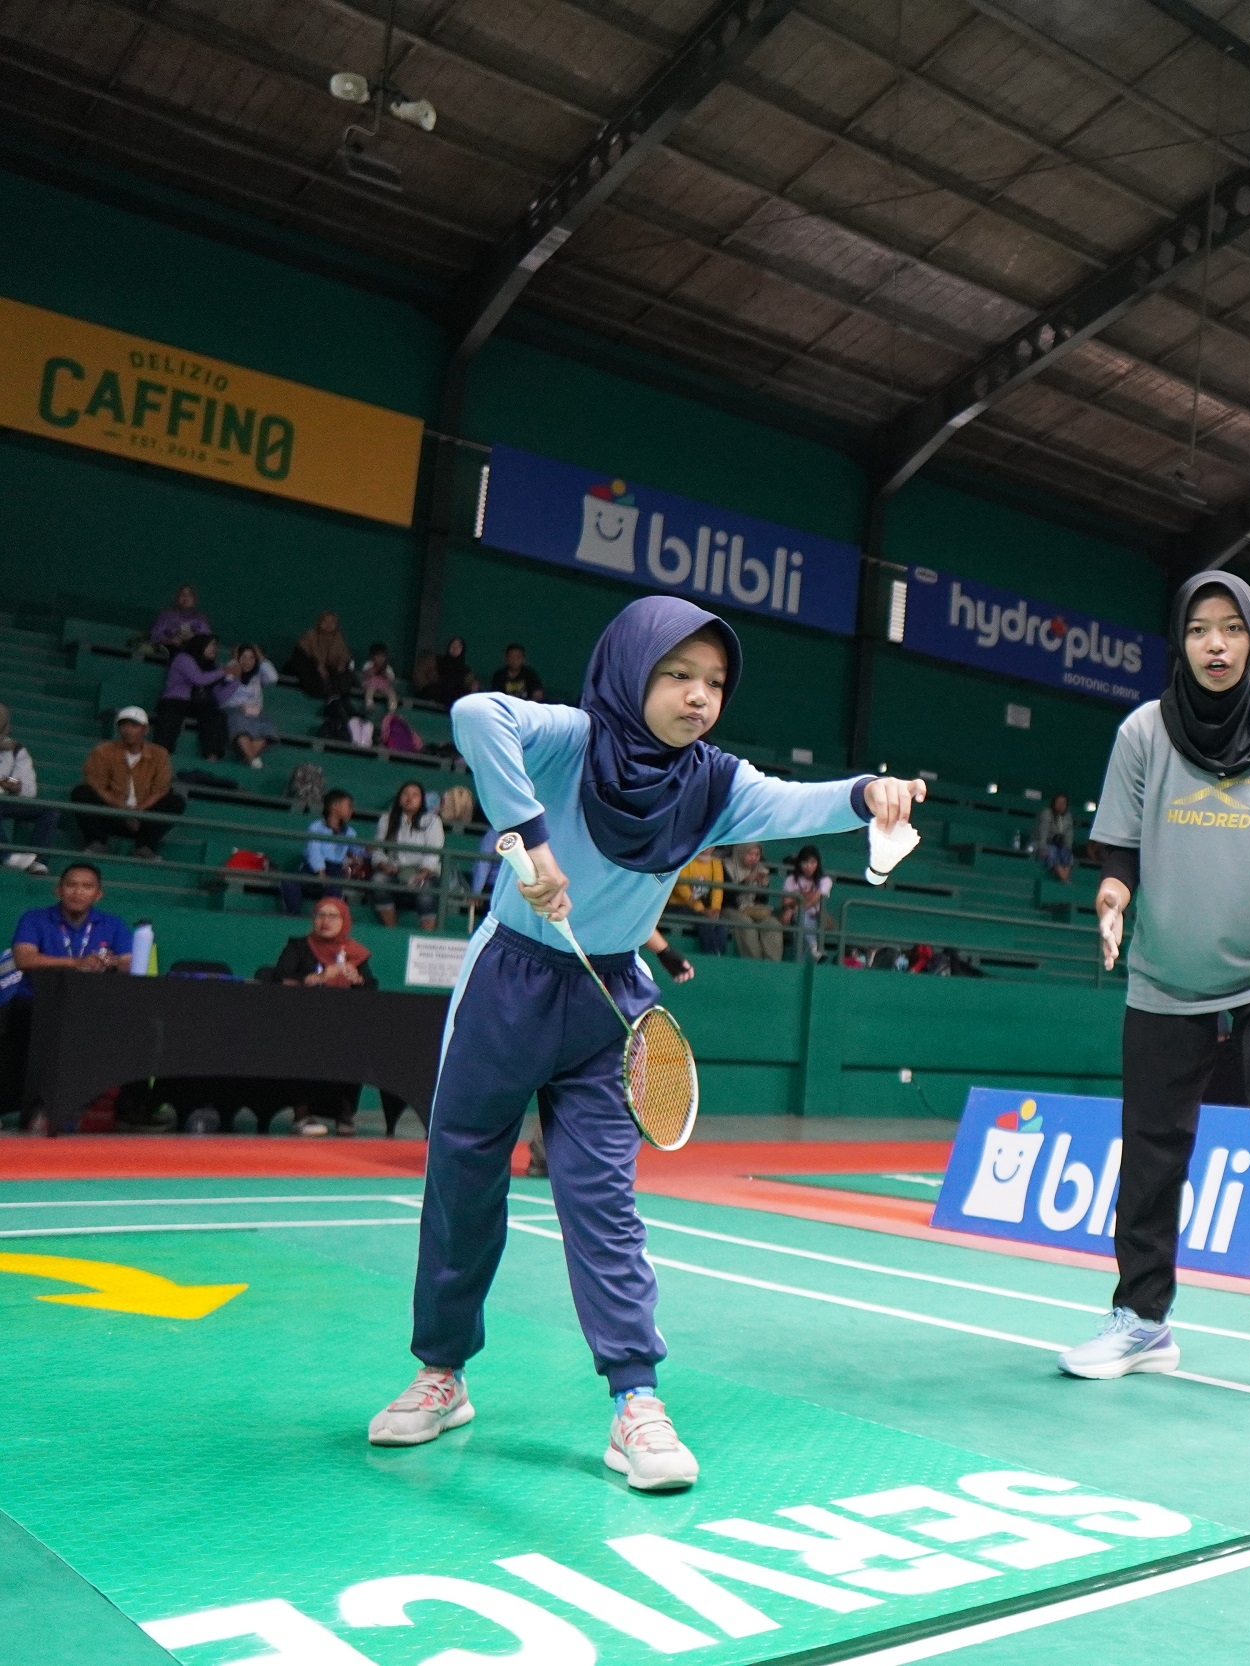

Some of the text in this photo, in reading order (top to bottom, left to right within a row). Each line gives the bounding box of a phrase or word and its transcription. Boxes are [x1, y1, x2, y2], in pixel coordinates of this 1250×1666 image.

[128, 350, 229, 392] DELIZIO
[646, 512, 804, 615] blibli
[949, 581, 1142, 674] hydroplus
[137, 1468, 1193, 1666] SERVICE
